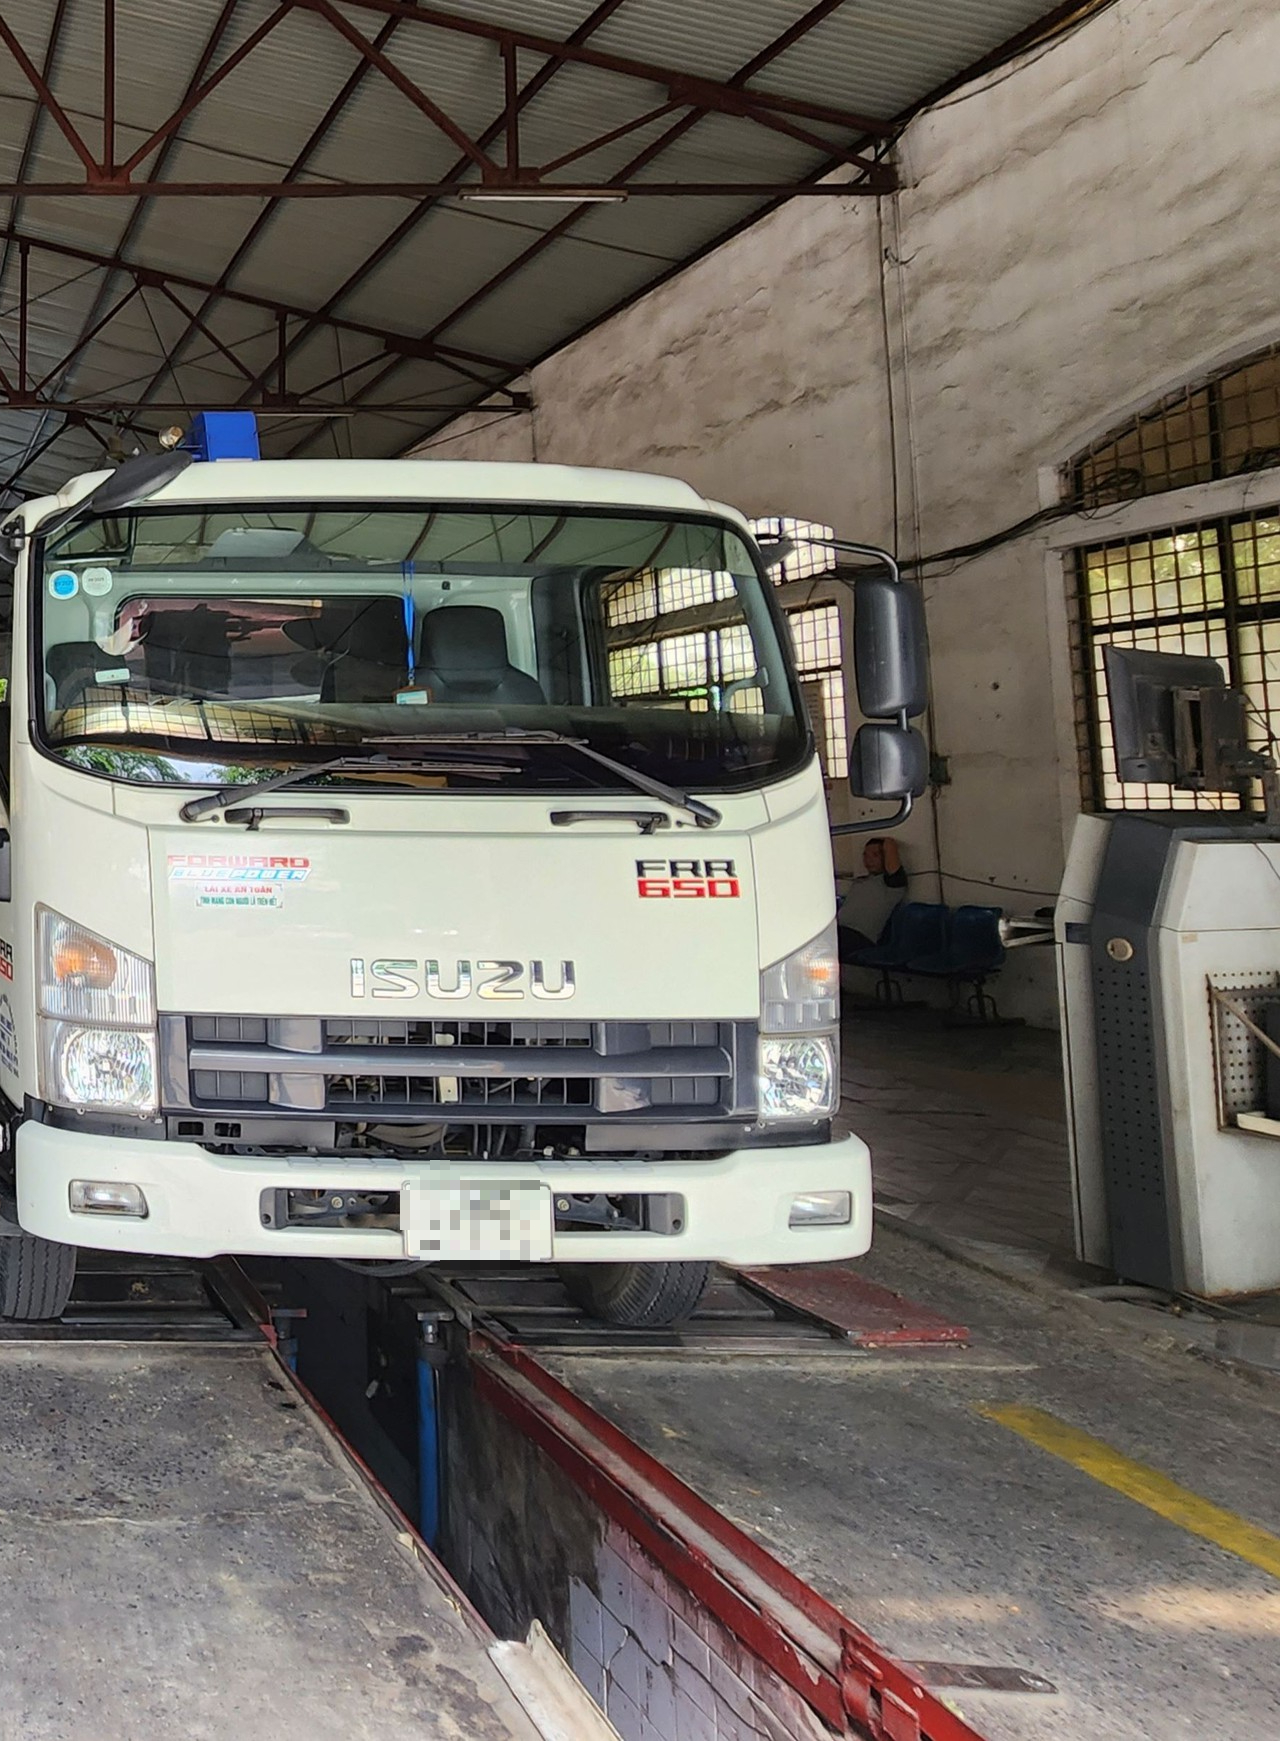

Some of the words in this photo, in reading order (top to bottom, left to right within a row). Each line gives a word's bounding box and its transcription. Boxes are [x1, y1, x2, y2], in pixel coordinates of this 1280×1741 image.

[168, 855, 310, 868] FORWARD
[635, 859, 738, 878] FRR
[637, 879, 740, 898] 650
[350, 958, 576, 1000] ISUZU
